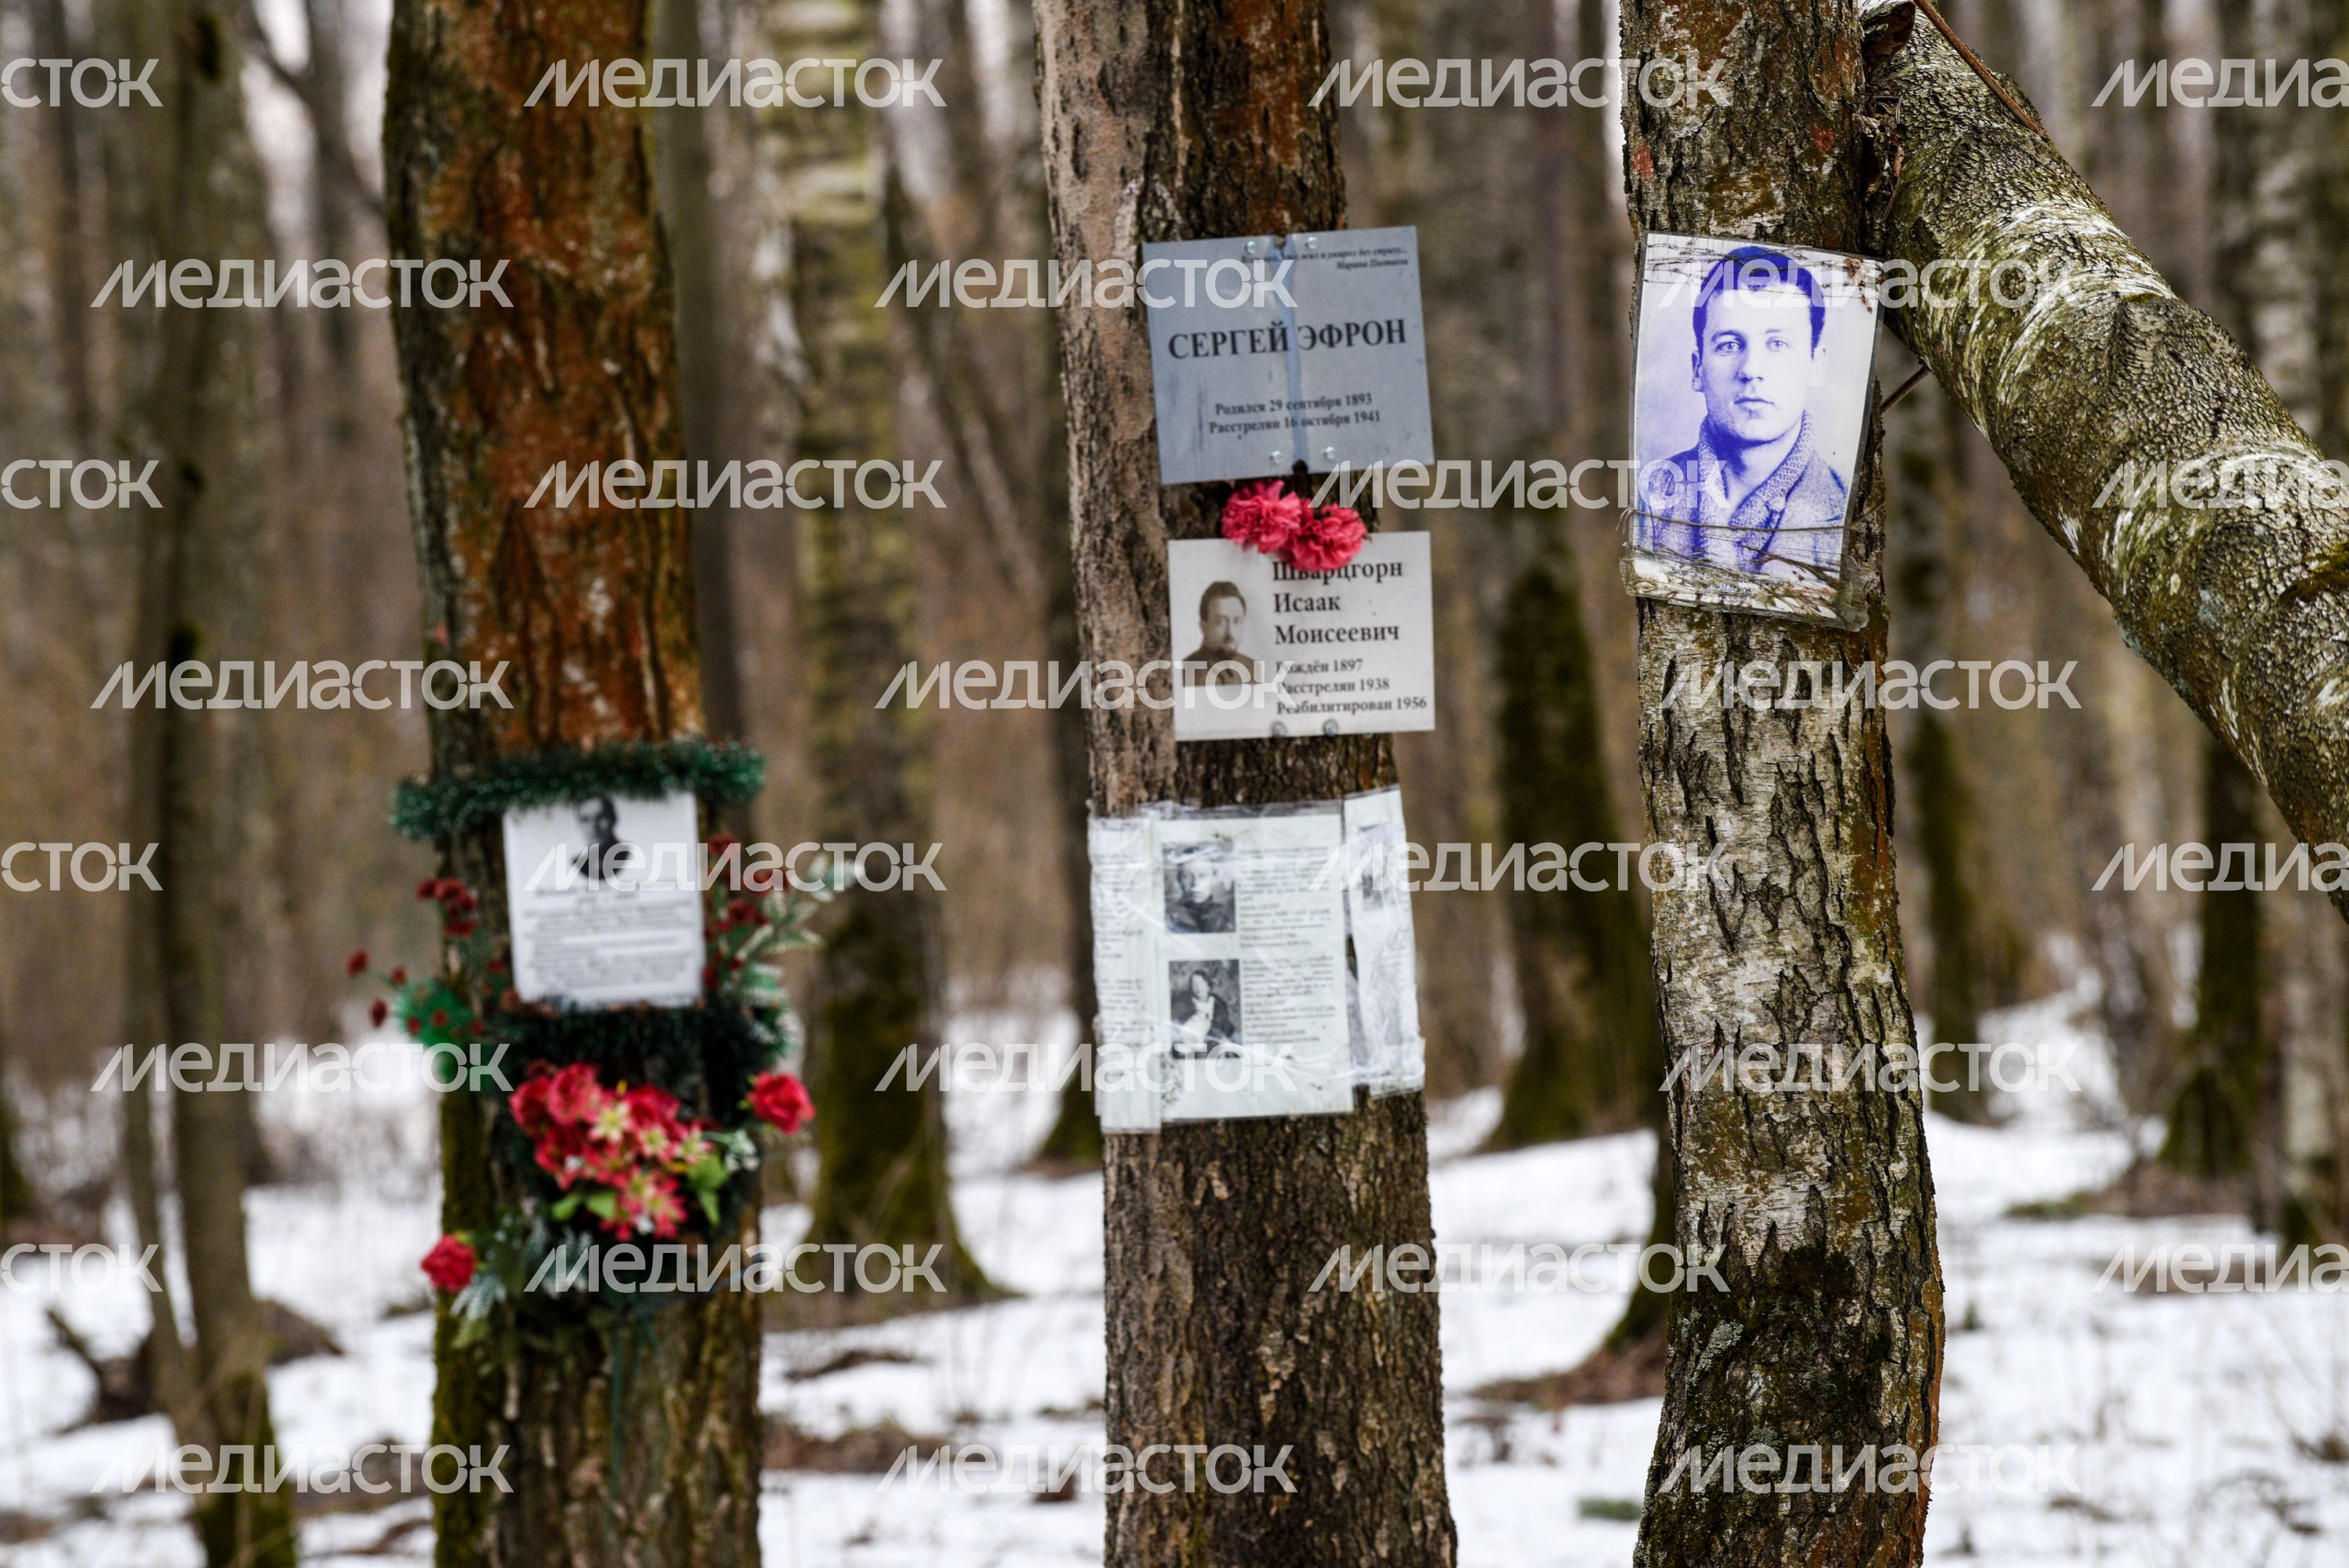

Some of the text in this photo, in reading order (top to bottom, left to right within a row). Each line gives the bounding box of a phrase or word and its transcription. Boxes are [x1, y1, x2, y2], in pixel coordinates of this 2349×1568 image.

[1168, 318, 1406, 359] СЕРГЕЙ ЭФРОН
[1214, 392, 1373, 416] Родился 29 сентября 1893
[1209, 410, 1381, 435] Расстрелян 16 октября 1941
[1274, 592, 1341, 613] Исаак
[1275, 624, 1400, 645] Моисеевич
[1333, 658, 1363, 672] 1897
[1360, 678, 1390, 691] 1938
[1397, 696, 1427, 710] 1956
